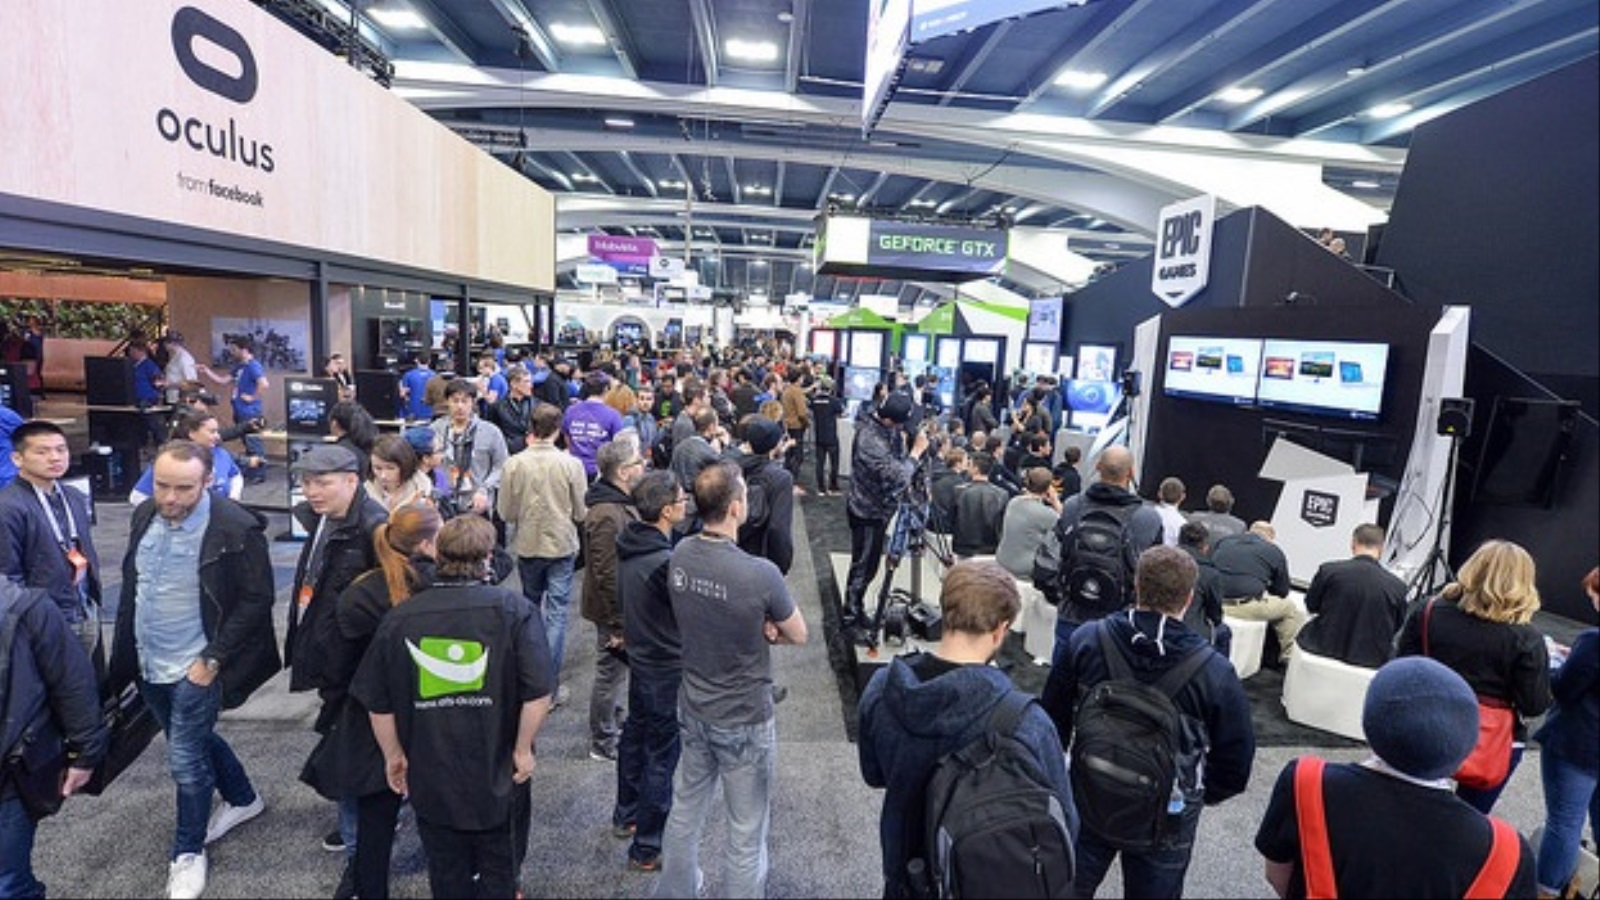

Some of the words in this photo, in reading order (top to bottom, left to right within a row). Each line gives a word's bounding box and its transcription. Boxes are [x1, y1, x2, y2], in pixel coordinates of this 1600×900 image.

[156, 107, 274, 173] oculus
[879, 235, 955, 254] GEFORCE
[962, 240, 996, 257] GTX
[1160, 210, 1201, 259] EPIC
